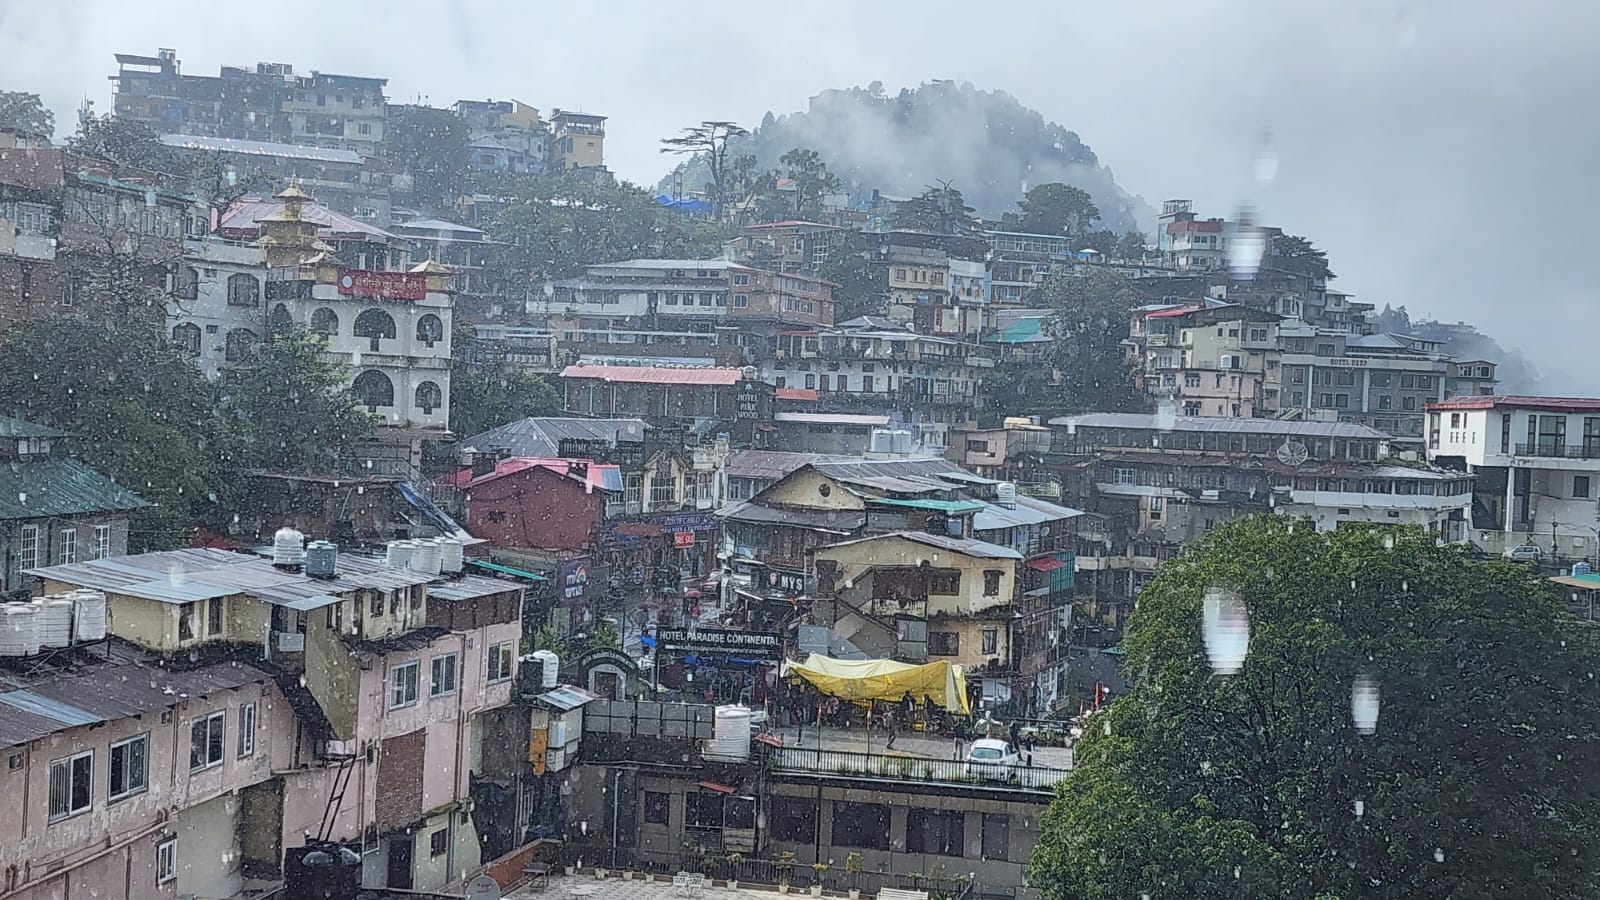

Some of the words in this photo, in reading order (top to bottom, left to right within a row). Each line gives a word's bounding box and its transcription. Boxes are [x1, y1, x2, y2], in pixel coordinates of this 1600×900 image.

[736, 393, 758, 402] HOTEL
[740, 403, 757, 411] PARK
[737, 411, 759, 420] WOOD
[781, 575, 803, 591] MYS
[659, 631, 686, 641] HOTEL
[686, 632, 726, 643] PARADISE
[726, 634, 780, 646] CONTINENTAL
